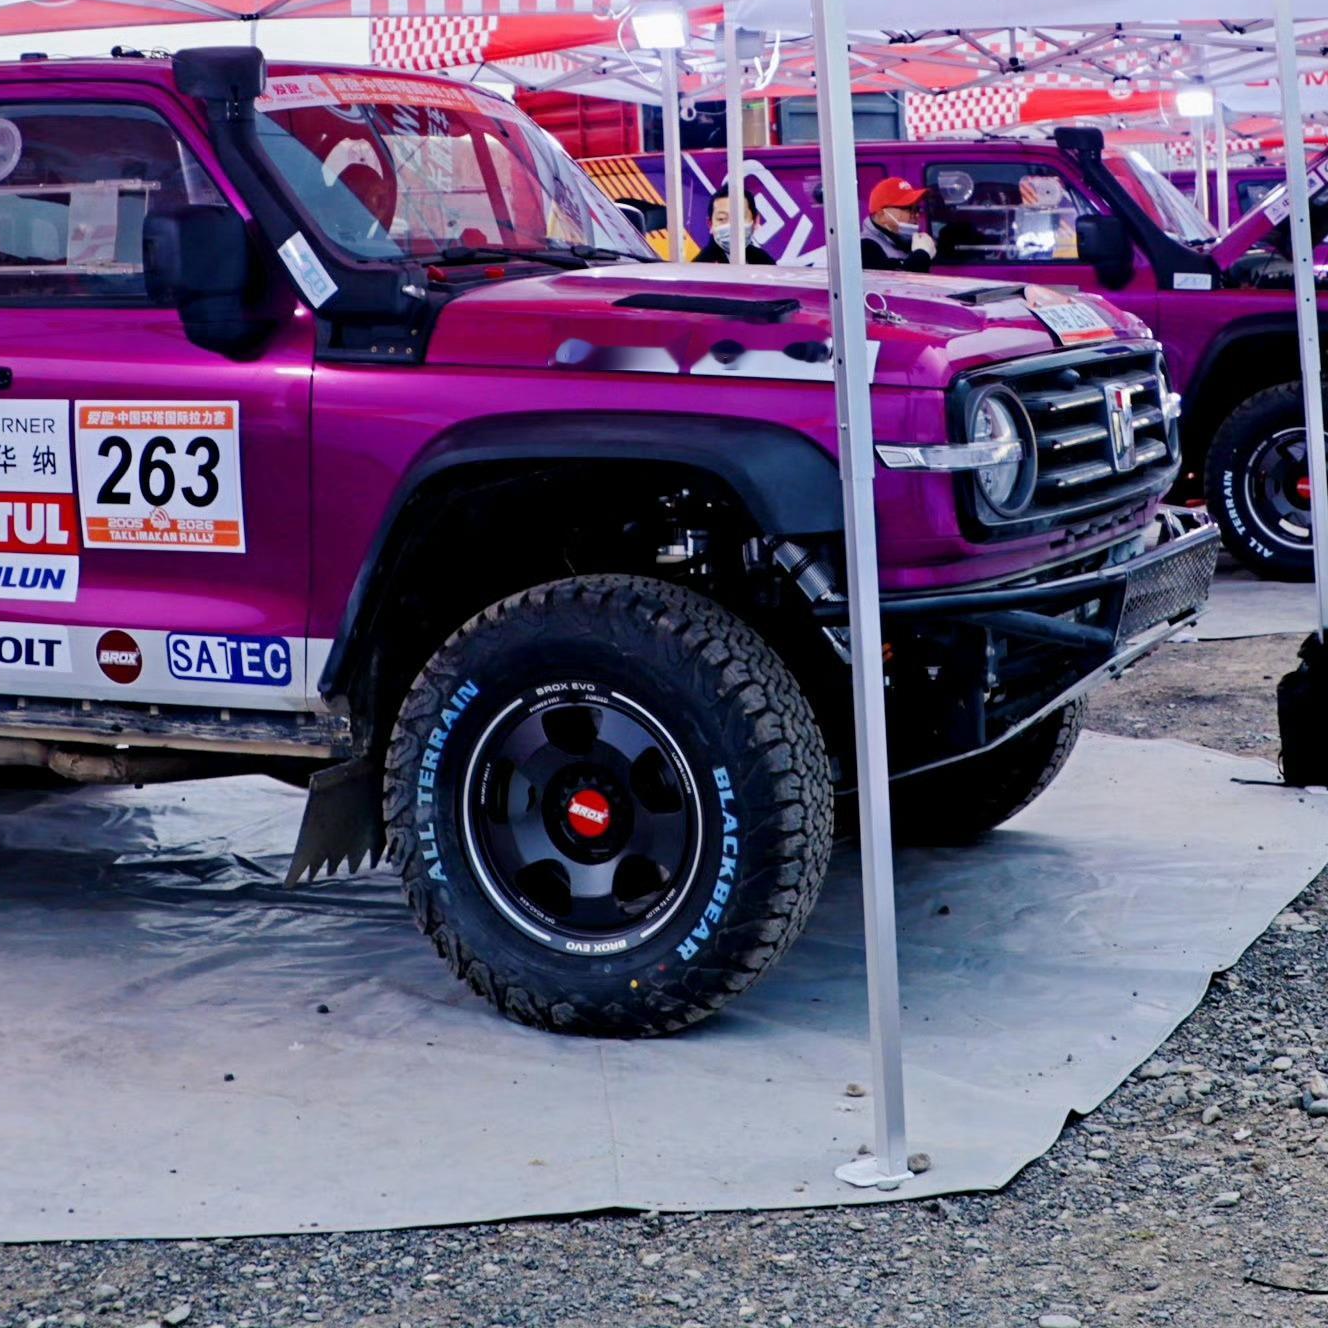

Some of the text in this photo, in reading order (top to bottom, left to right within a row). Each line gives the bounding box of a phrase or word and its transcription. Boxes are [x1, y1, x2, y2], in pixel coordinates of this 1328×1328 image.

[96, 435, 220, 508] 263
[107, 517, 215, 531] 2005 2026
[1223, 470, 1274, 558] ALL TERRAIN
[109, 530, 215, 544] TAKLIMAKAN RALLY
[99, 650, 139, 666] BROX
[172, 638, 288, 680] SATEC
[535, 682, 596, 696] BROX EVO
[416, 679, 481, 882] ALL TERRAIN
[675, 765, 738, 962] BLACKBEAR
[565, 939, 627, 953] BROX EVO
